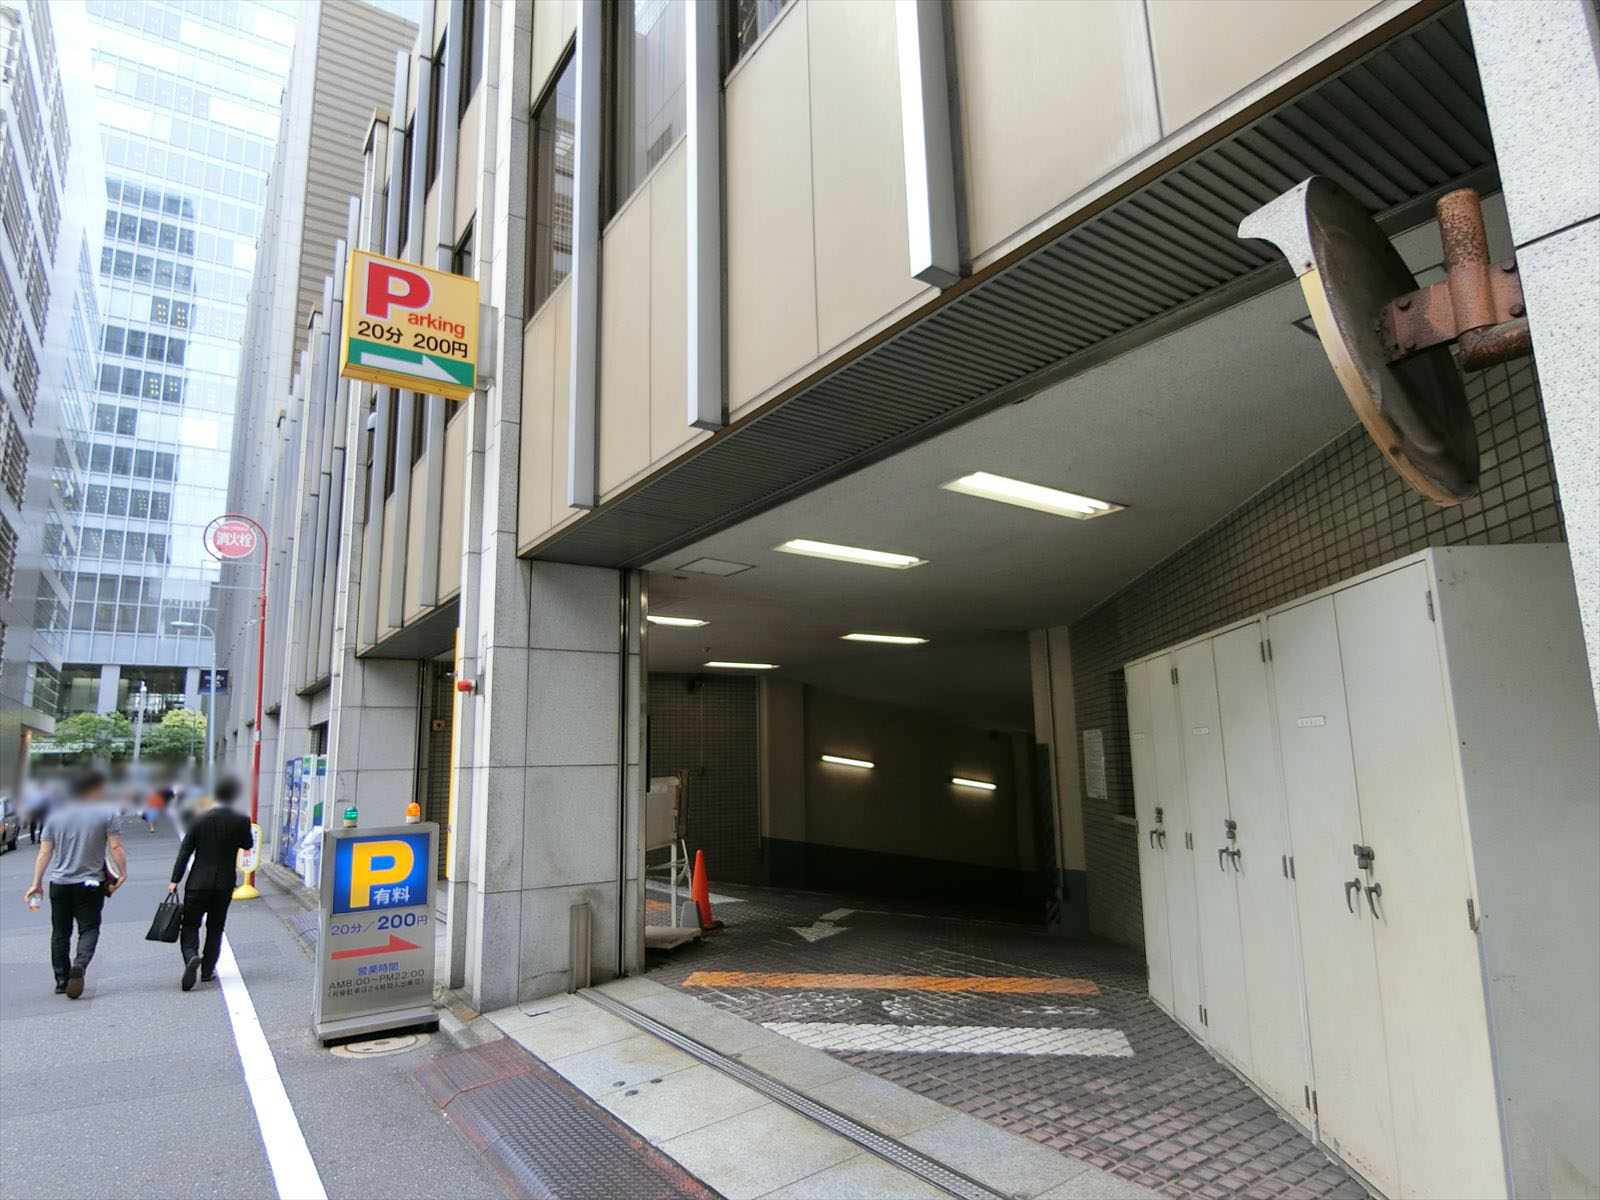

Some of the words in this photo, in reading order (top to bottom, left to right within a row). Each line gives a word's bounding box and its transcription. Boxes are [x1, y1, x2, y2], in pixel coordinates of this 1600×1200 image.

[357, 320, 404, 344] 20分
[413, 333, 468, 358] 200円
[217, 531, 252, 547] 消火栓
[350, 840, 414, 908] P
[373, 885, 410, 905] 有料
[328, 968, 425, 990] AM800~PM22:00
[358, 962, 399, 976] 営業時間
